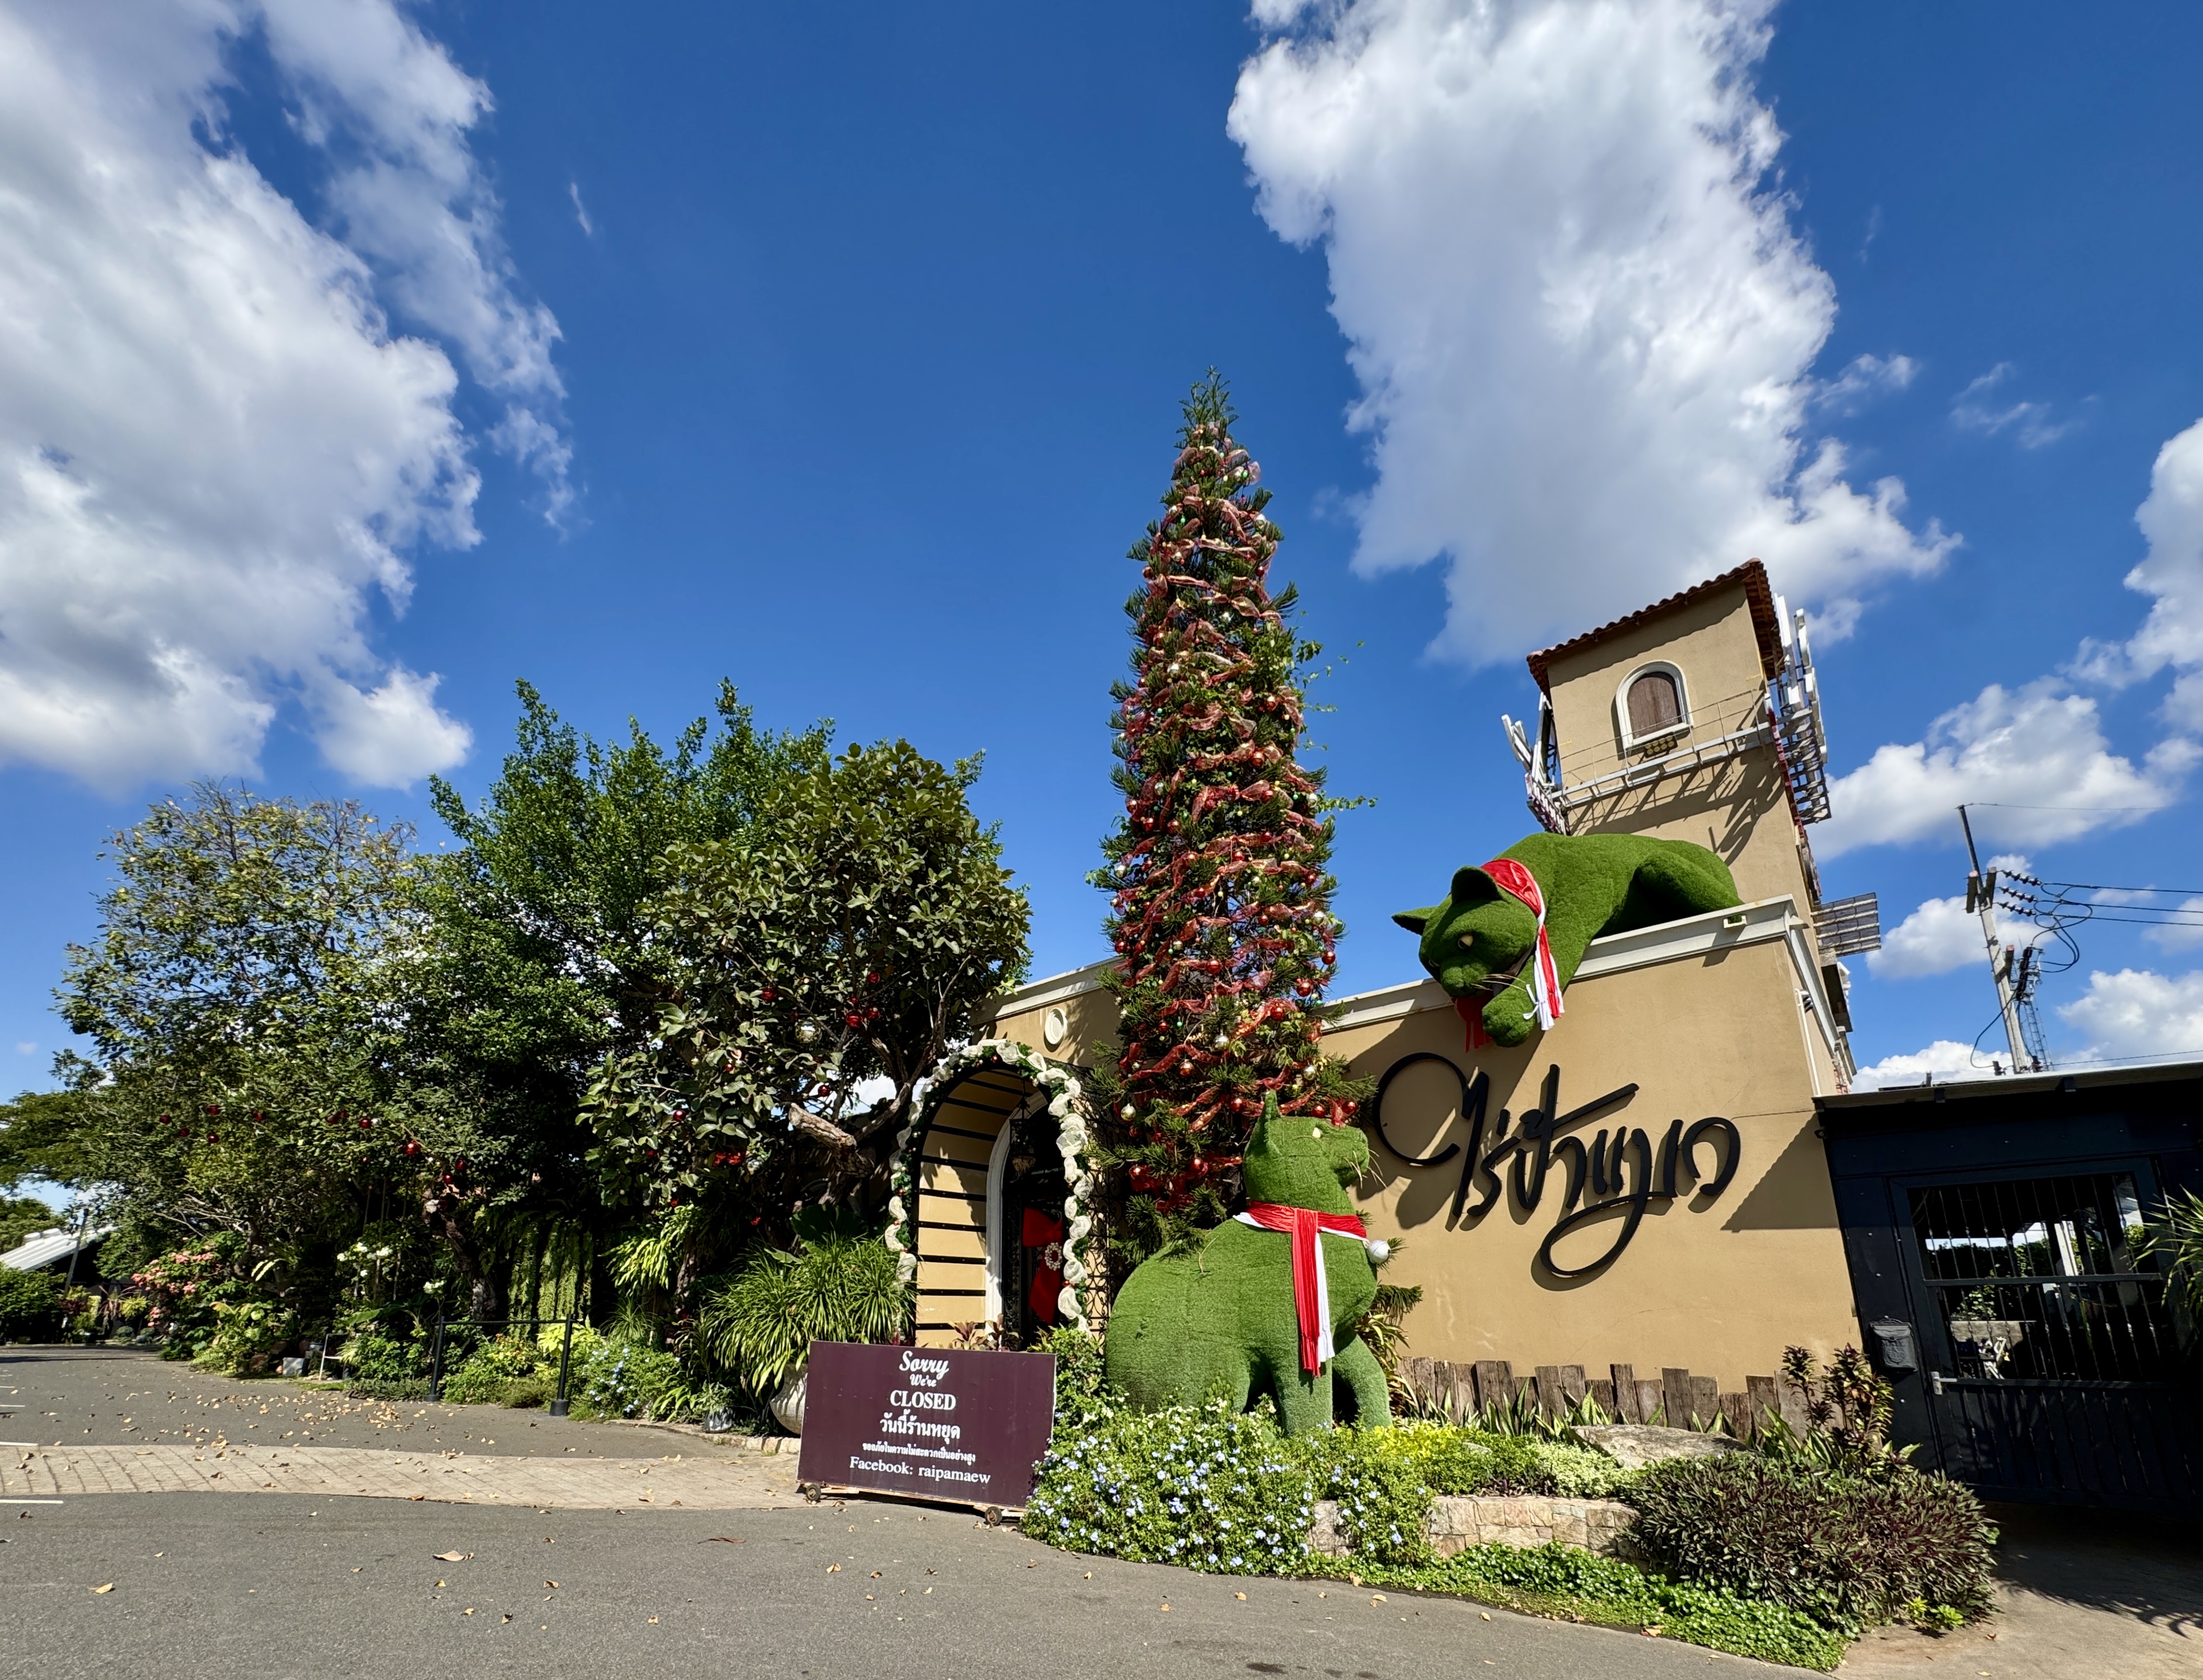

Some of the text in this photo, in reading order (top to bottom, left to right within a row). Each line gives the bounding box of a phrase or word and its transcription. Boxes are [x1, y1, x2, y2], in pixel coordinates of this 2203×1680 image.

[899, 1350, 949, 1380] Sorry
[909, 1373, 937, 1388] We're
[890, 1389, 956, 1410] CLOSED
[879, 1409, 961, 1445] วันนี้ร้านหยุด
[850, 1456, 991, 1484] Facebook: raipamaew
